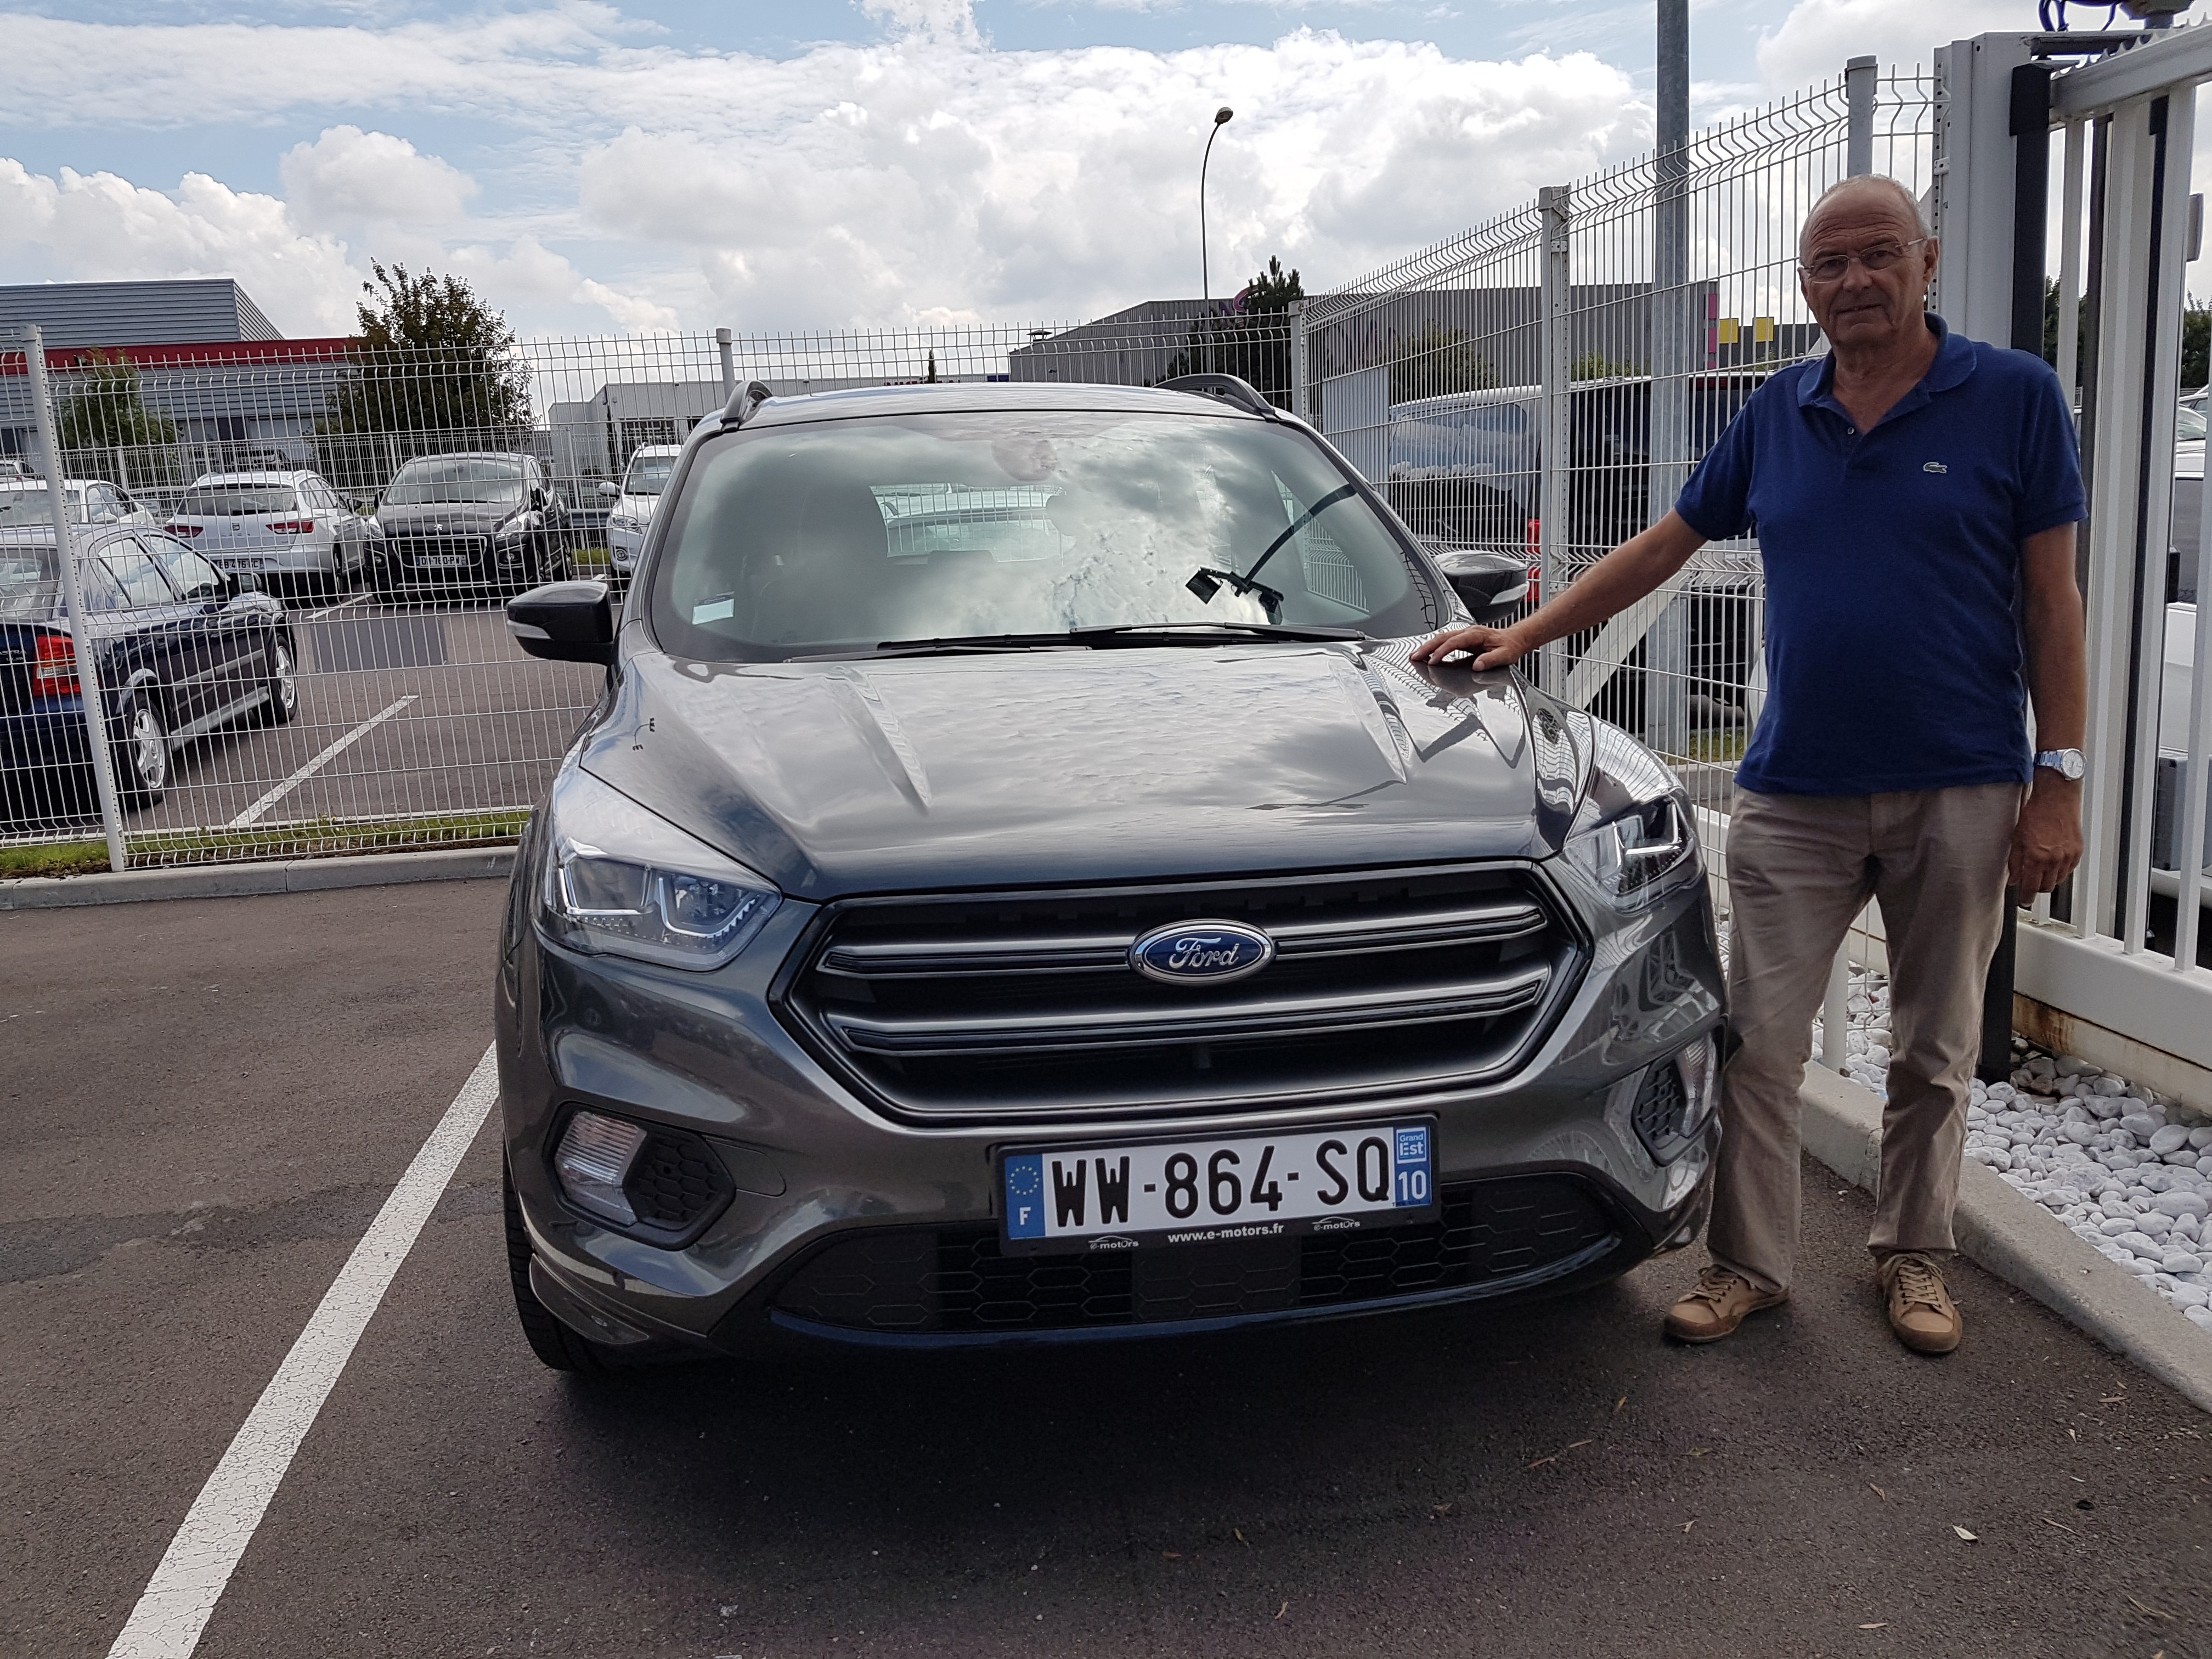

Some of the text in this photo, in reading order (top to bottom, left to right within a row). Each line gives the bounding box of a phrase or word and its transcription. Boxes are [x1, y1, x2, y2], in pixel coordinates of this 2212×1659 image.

[1169, 937, 1239, 968] Ford
[1400, 1133, 1424, 1142] Grand
[1400, 1141, 1424, 1156] Est
[1398, 1170, 1426, 1200] 10
[1019, 1206, 1031, 1225] F
[1167, 1223, 1284, 1243] www.e-motors.fr
